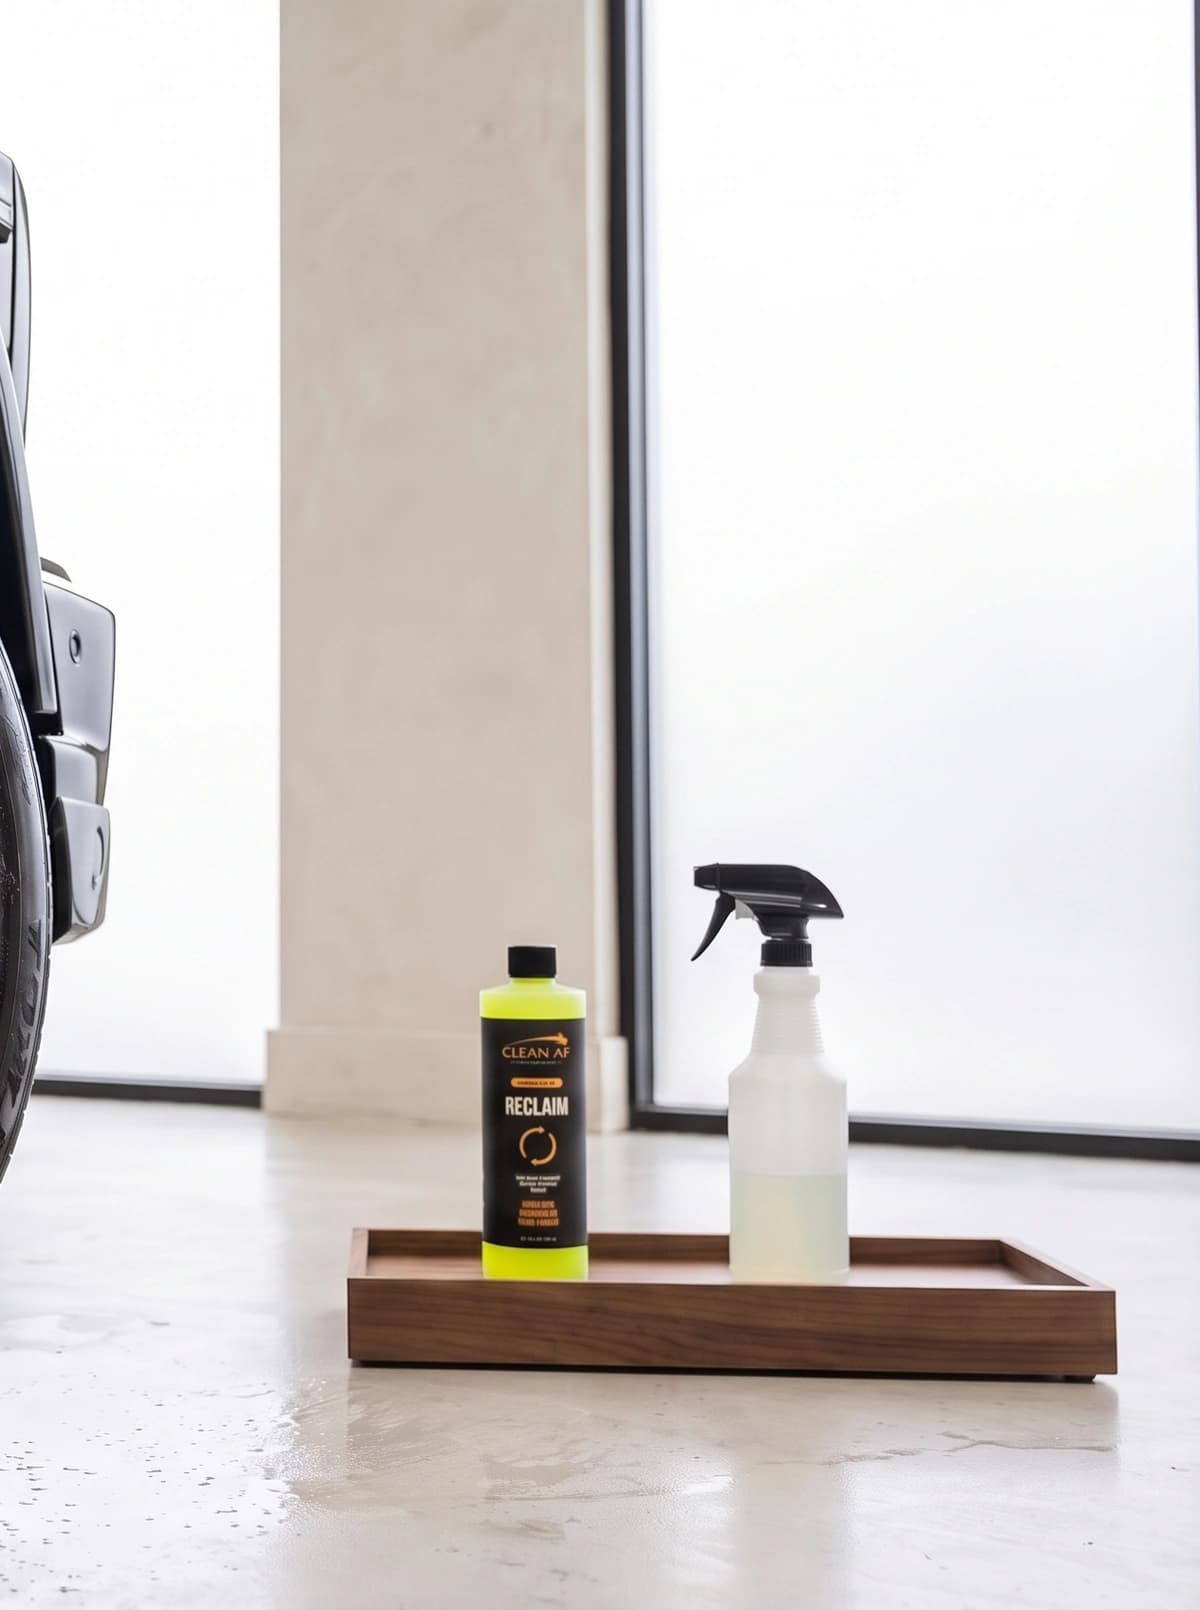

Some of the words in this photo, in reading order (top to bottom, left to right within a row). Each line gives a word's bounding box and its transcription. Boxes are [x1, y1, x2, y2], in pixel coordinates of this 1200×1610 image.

[502, 1046, 548, 1058] CLEAN
[553, 1047, 571, 1058] AF
[505, 1096, 569, 1116] RECLAIM
